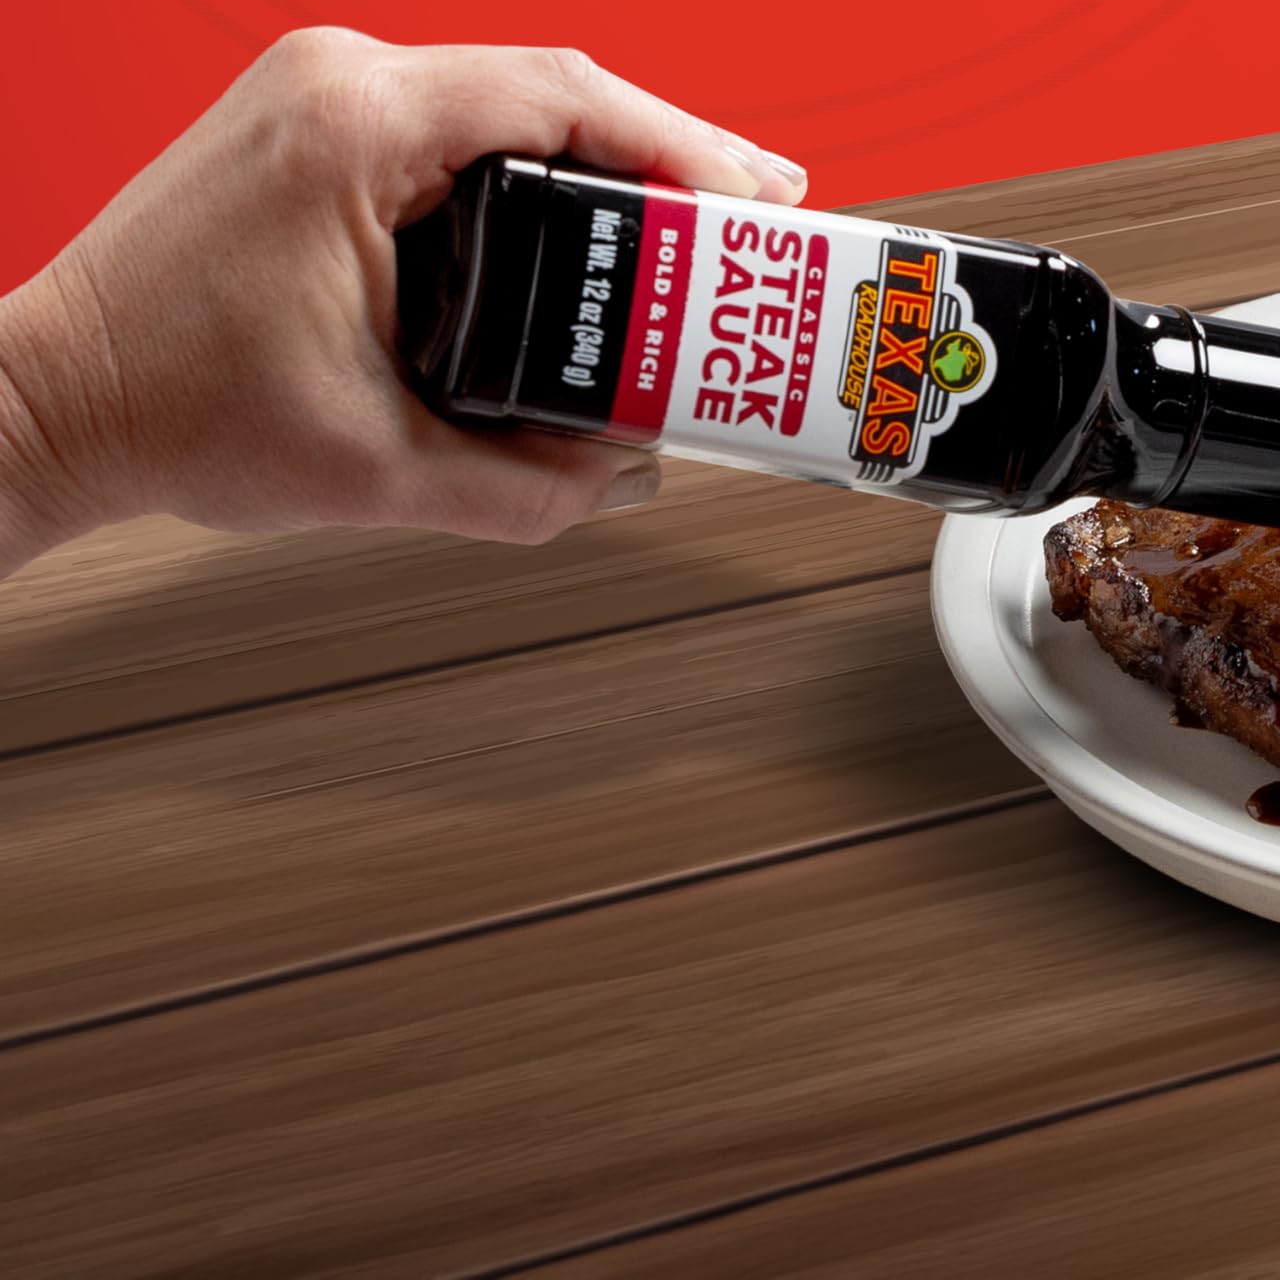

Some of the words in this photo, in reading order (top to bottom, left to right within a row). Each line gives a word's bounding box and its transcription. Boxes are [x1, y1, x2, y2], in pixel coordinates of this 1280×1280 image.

[591, 208, 622, 242] Net
[587, 243, 617, 272] Wt.
[654, 228, 678, 295] BOLD
[579, 302, 603, 324] oz
[582, 278, 611, 301] 12
[649, 302, 668, 321] &
[569, 324, 605, 367] (340
[693, 216, 760, 425] SAUCE
[737, 226, 801, 430] STEAK
[789, 267, 822, 402] CLASSIC
[843, 283, 879, 410] ROADHOUSE
[561, 366, 596, 388] g)
[637, 329, 663, 390] RICH
[862, 253, 938, 456] TEXAS
